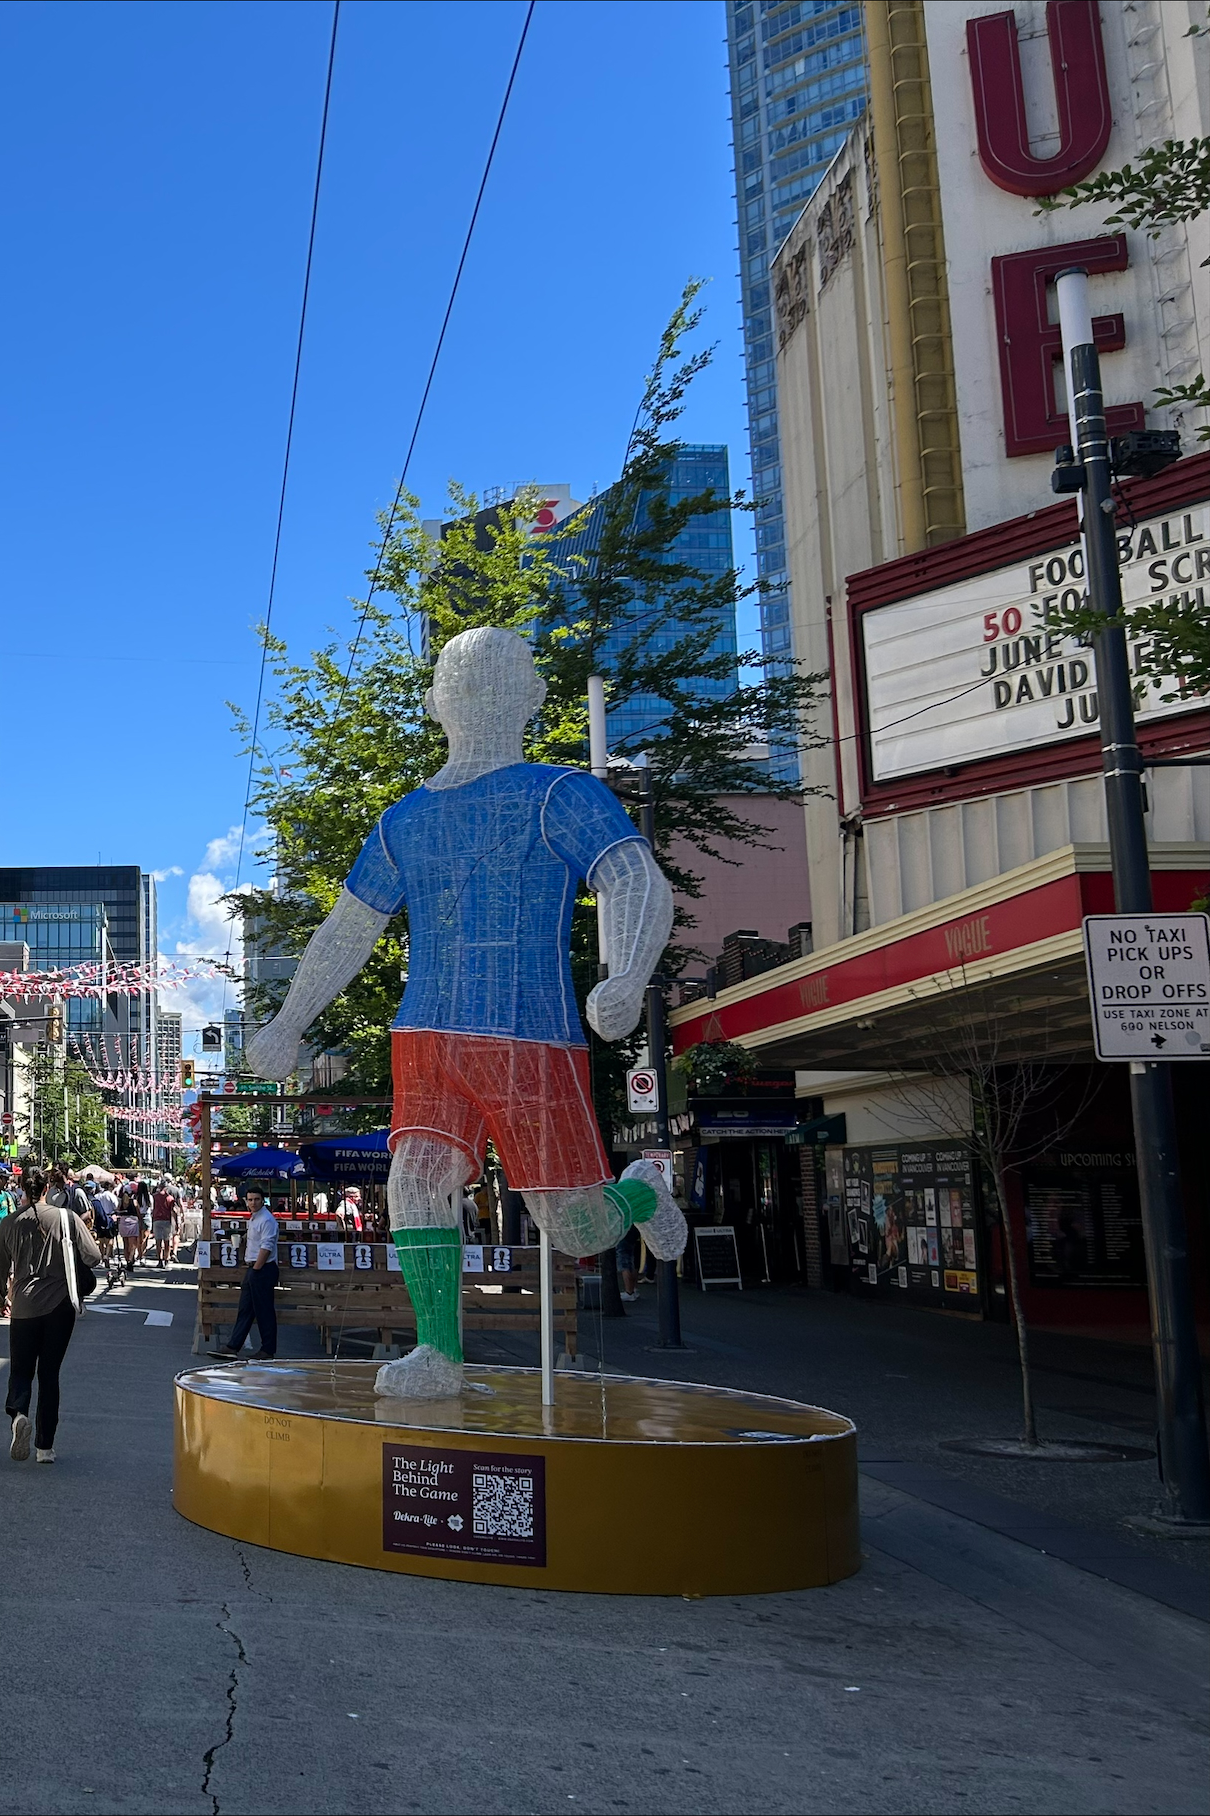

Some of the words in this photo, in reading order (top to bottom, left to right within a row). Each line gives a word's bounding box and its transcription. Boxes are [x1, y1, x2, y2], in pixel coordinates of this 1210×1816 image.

[1028, 514, 1203, 593] FOOBALL
[983, 607, 1022, 642] 50
[1148, 547, 1210, 592] SCR
[980, 629, 1062, 677] JUNE
[993, 659, 1088, 709] DAVID
[30, 909, 78, 920] Microsoft
[944, 915, 993, 961] VOGUE
[1110, 929, 1137, 944] NO
[1147, 928, 1186, 943] TAXI
[1108, 947, 1149, 962] PICK
[1159, 946, 1193, 960] UPS
[1140, 966, 1165, 980] OR
[1102, 985, 1152, 1000] DROP
[1162, 984, 1206, 998] OFFS
[1104, 1010, 1124, 1019] USE
[1130, 1010, 1154, 1018] TAXI
[1160, 1009, 1190, 1018] ZONE
[1196, 1008, 1209, 1017] AT
[1149, 1021, 1194, 1030] NELSON
[335, 1150, 360, 1158] FIFA
[360, 1150, 393, 1158] WORL
[1060, 1154, 1122, 1166] UPCOMING
[334, 1163, 359, 1171] FIFA
[360, 1163, 388, 1172] WORL
[264, 1416, 274, 1424] DO
[276, 1418, 292, 1428] NOT
[266, 1430, 290, 1442] CLIMB
[392, 1456, 417, 1471] The
[420, 1460, 454, 1476] Light
[473, 1464, 490, 1472] Scan
[490, 1465, 501, 1473] for
[393, 1470, 438, 1486] Behind
[392, 1484, 417, 1497] The
[420, 1487, 458, 1501] Game
[393, 1510, 438, 1527] Dekra-Lite
